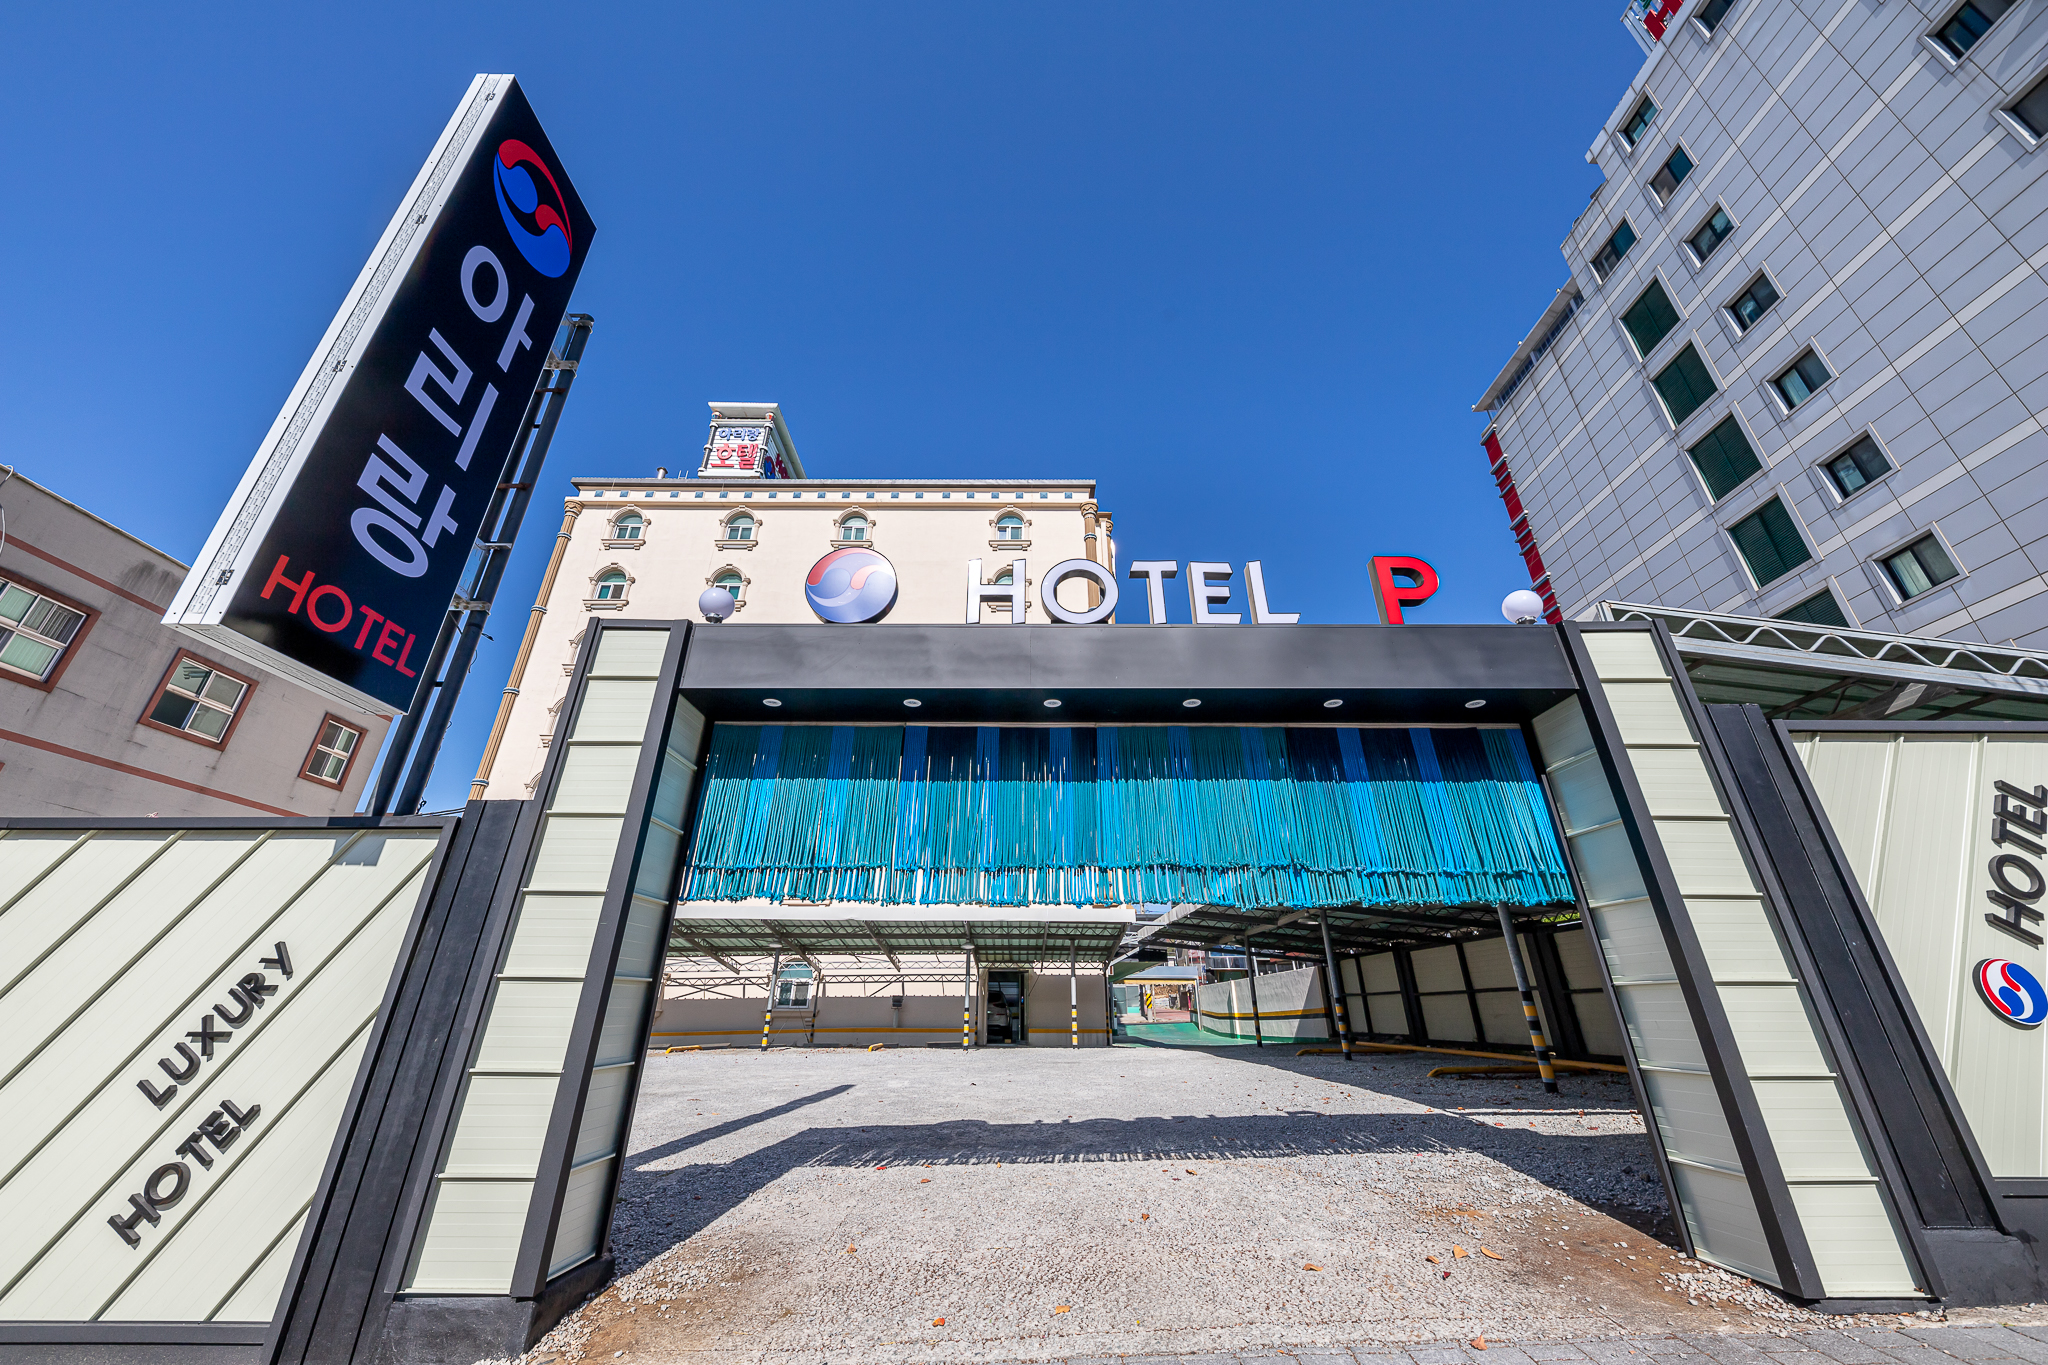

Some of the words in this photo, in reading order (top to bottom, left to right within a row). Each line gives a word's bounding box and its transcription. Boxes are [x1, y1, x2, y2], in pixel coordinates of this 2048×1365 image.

[350, 245, 534, 578] 아리랑
[710, 443, 758, 469] 호텔
[719, 428, 761, 441] 아리랑
[260, 554, 416, 678] HOTEL
[966, 558, 1300, 624] HOTEL
[1367, 555, 1440, 625] P
[1985, 780, 2048, 950] HOTEL
[136, 941, 294, 1111] LUXURY
[107, 1099, 261, 1250] HOTEL
